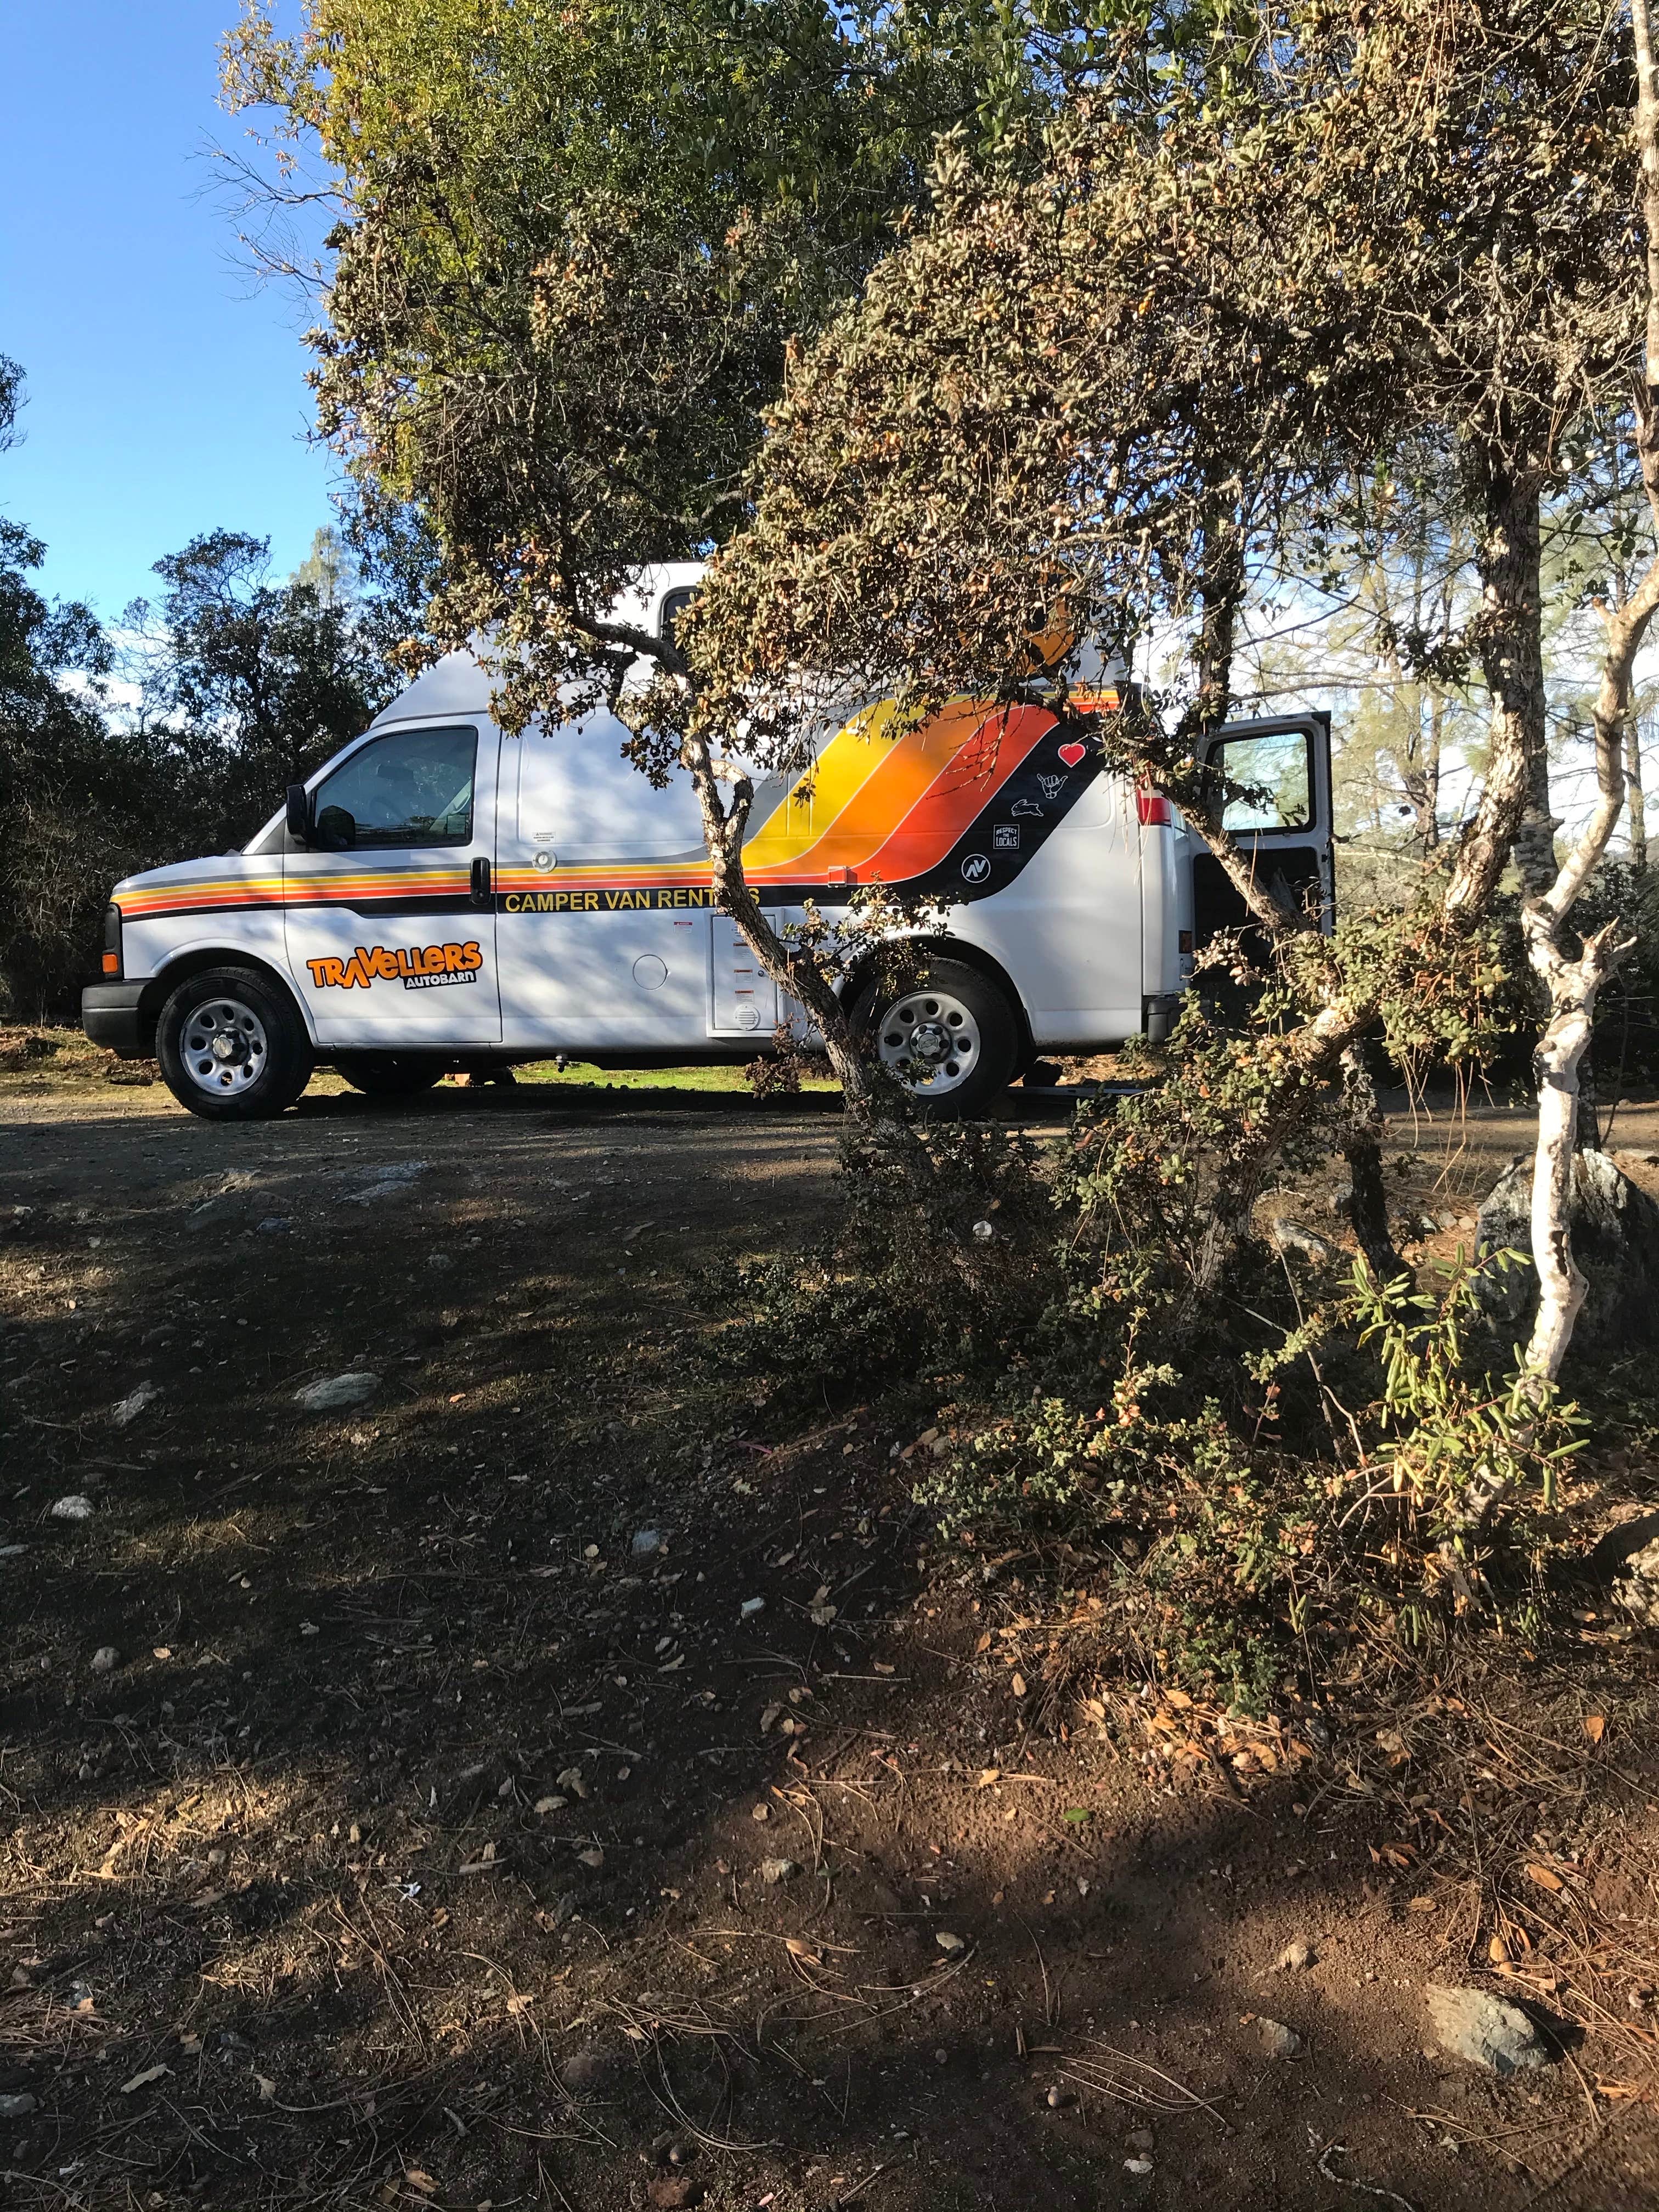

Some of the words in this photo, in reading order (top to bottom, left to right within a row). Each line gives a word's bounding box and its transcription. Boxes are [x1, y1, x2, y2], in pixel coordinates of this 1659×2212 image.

[996, 837, 1017, 846] LOCALS
[505, 893, 599, 912] CAMPER
[605, 891, 650, 909] VAN
[658, 888, 760, 907] RENTS
